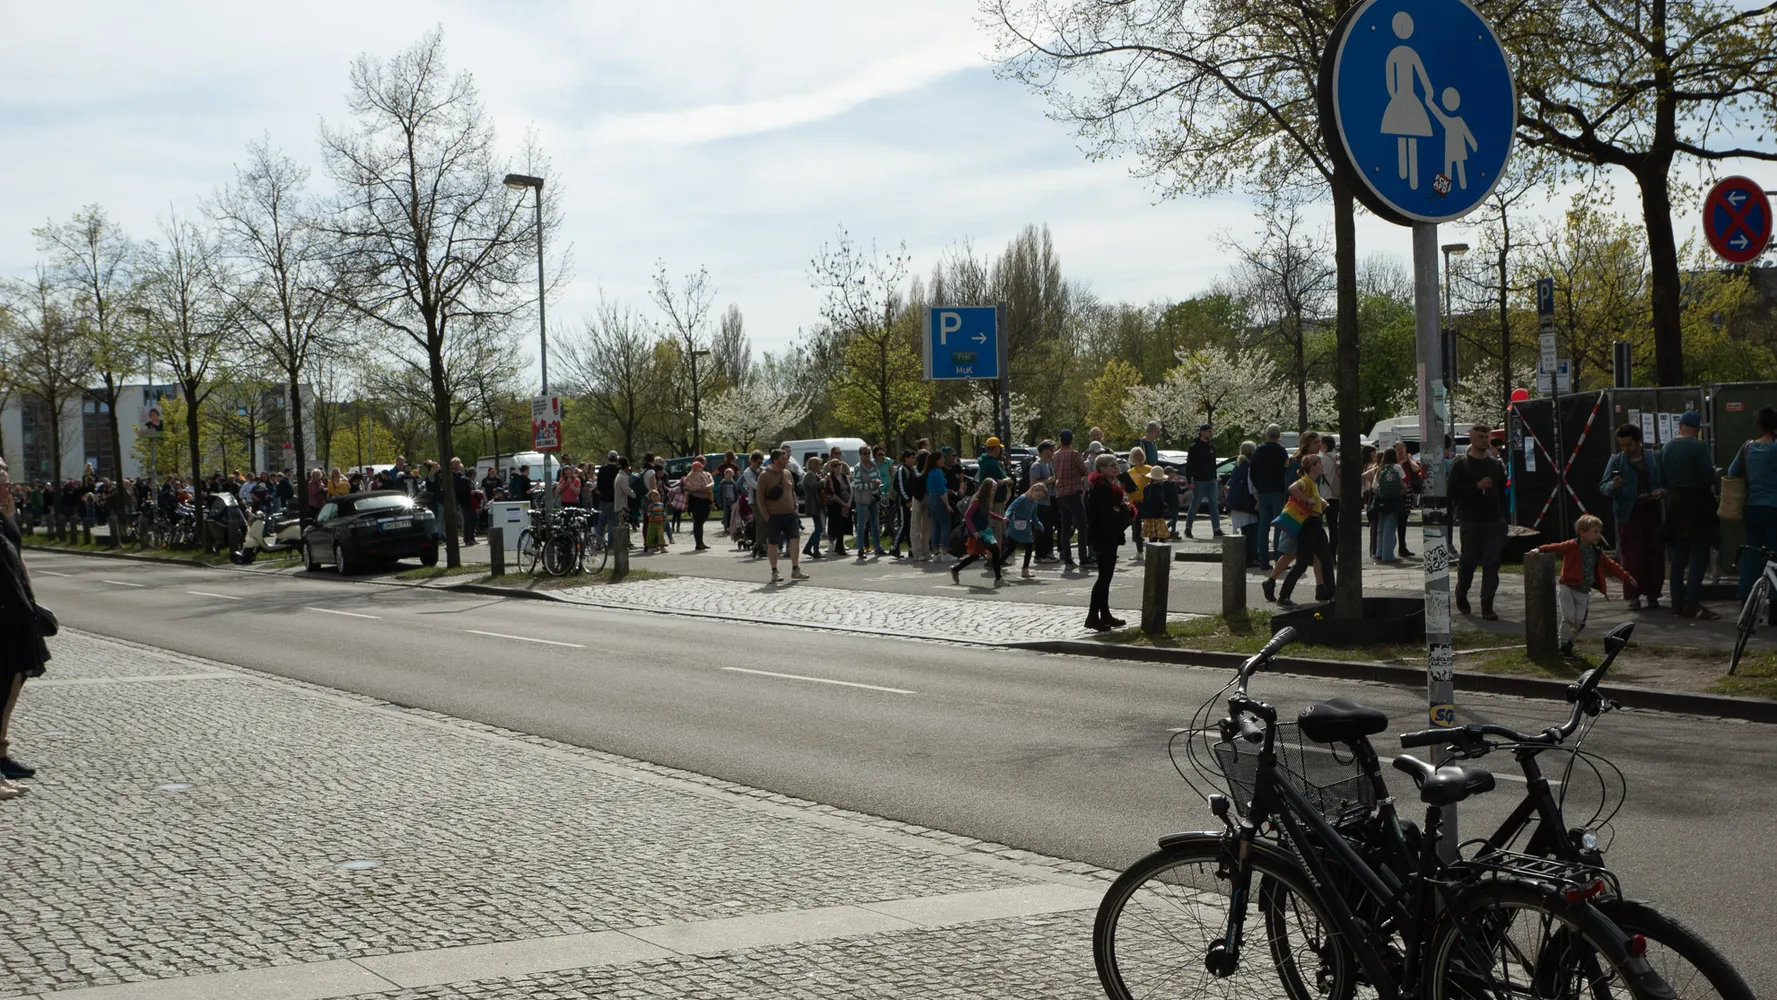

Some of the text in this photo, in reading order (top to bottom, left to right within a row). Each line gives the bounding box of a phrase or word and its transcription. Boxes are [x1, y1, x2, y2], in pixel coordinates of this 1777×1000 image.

[1435, 174, 1449, 188] FCK
[1540, 283, 1550, 310] P
[940, 311, 962, 345] P
[956, 366, 973, 375] MuK
